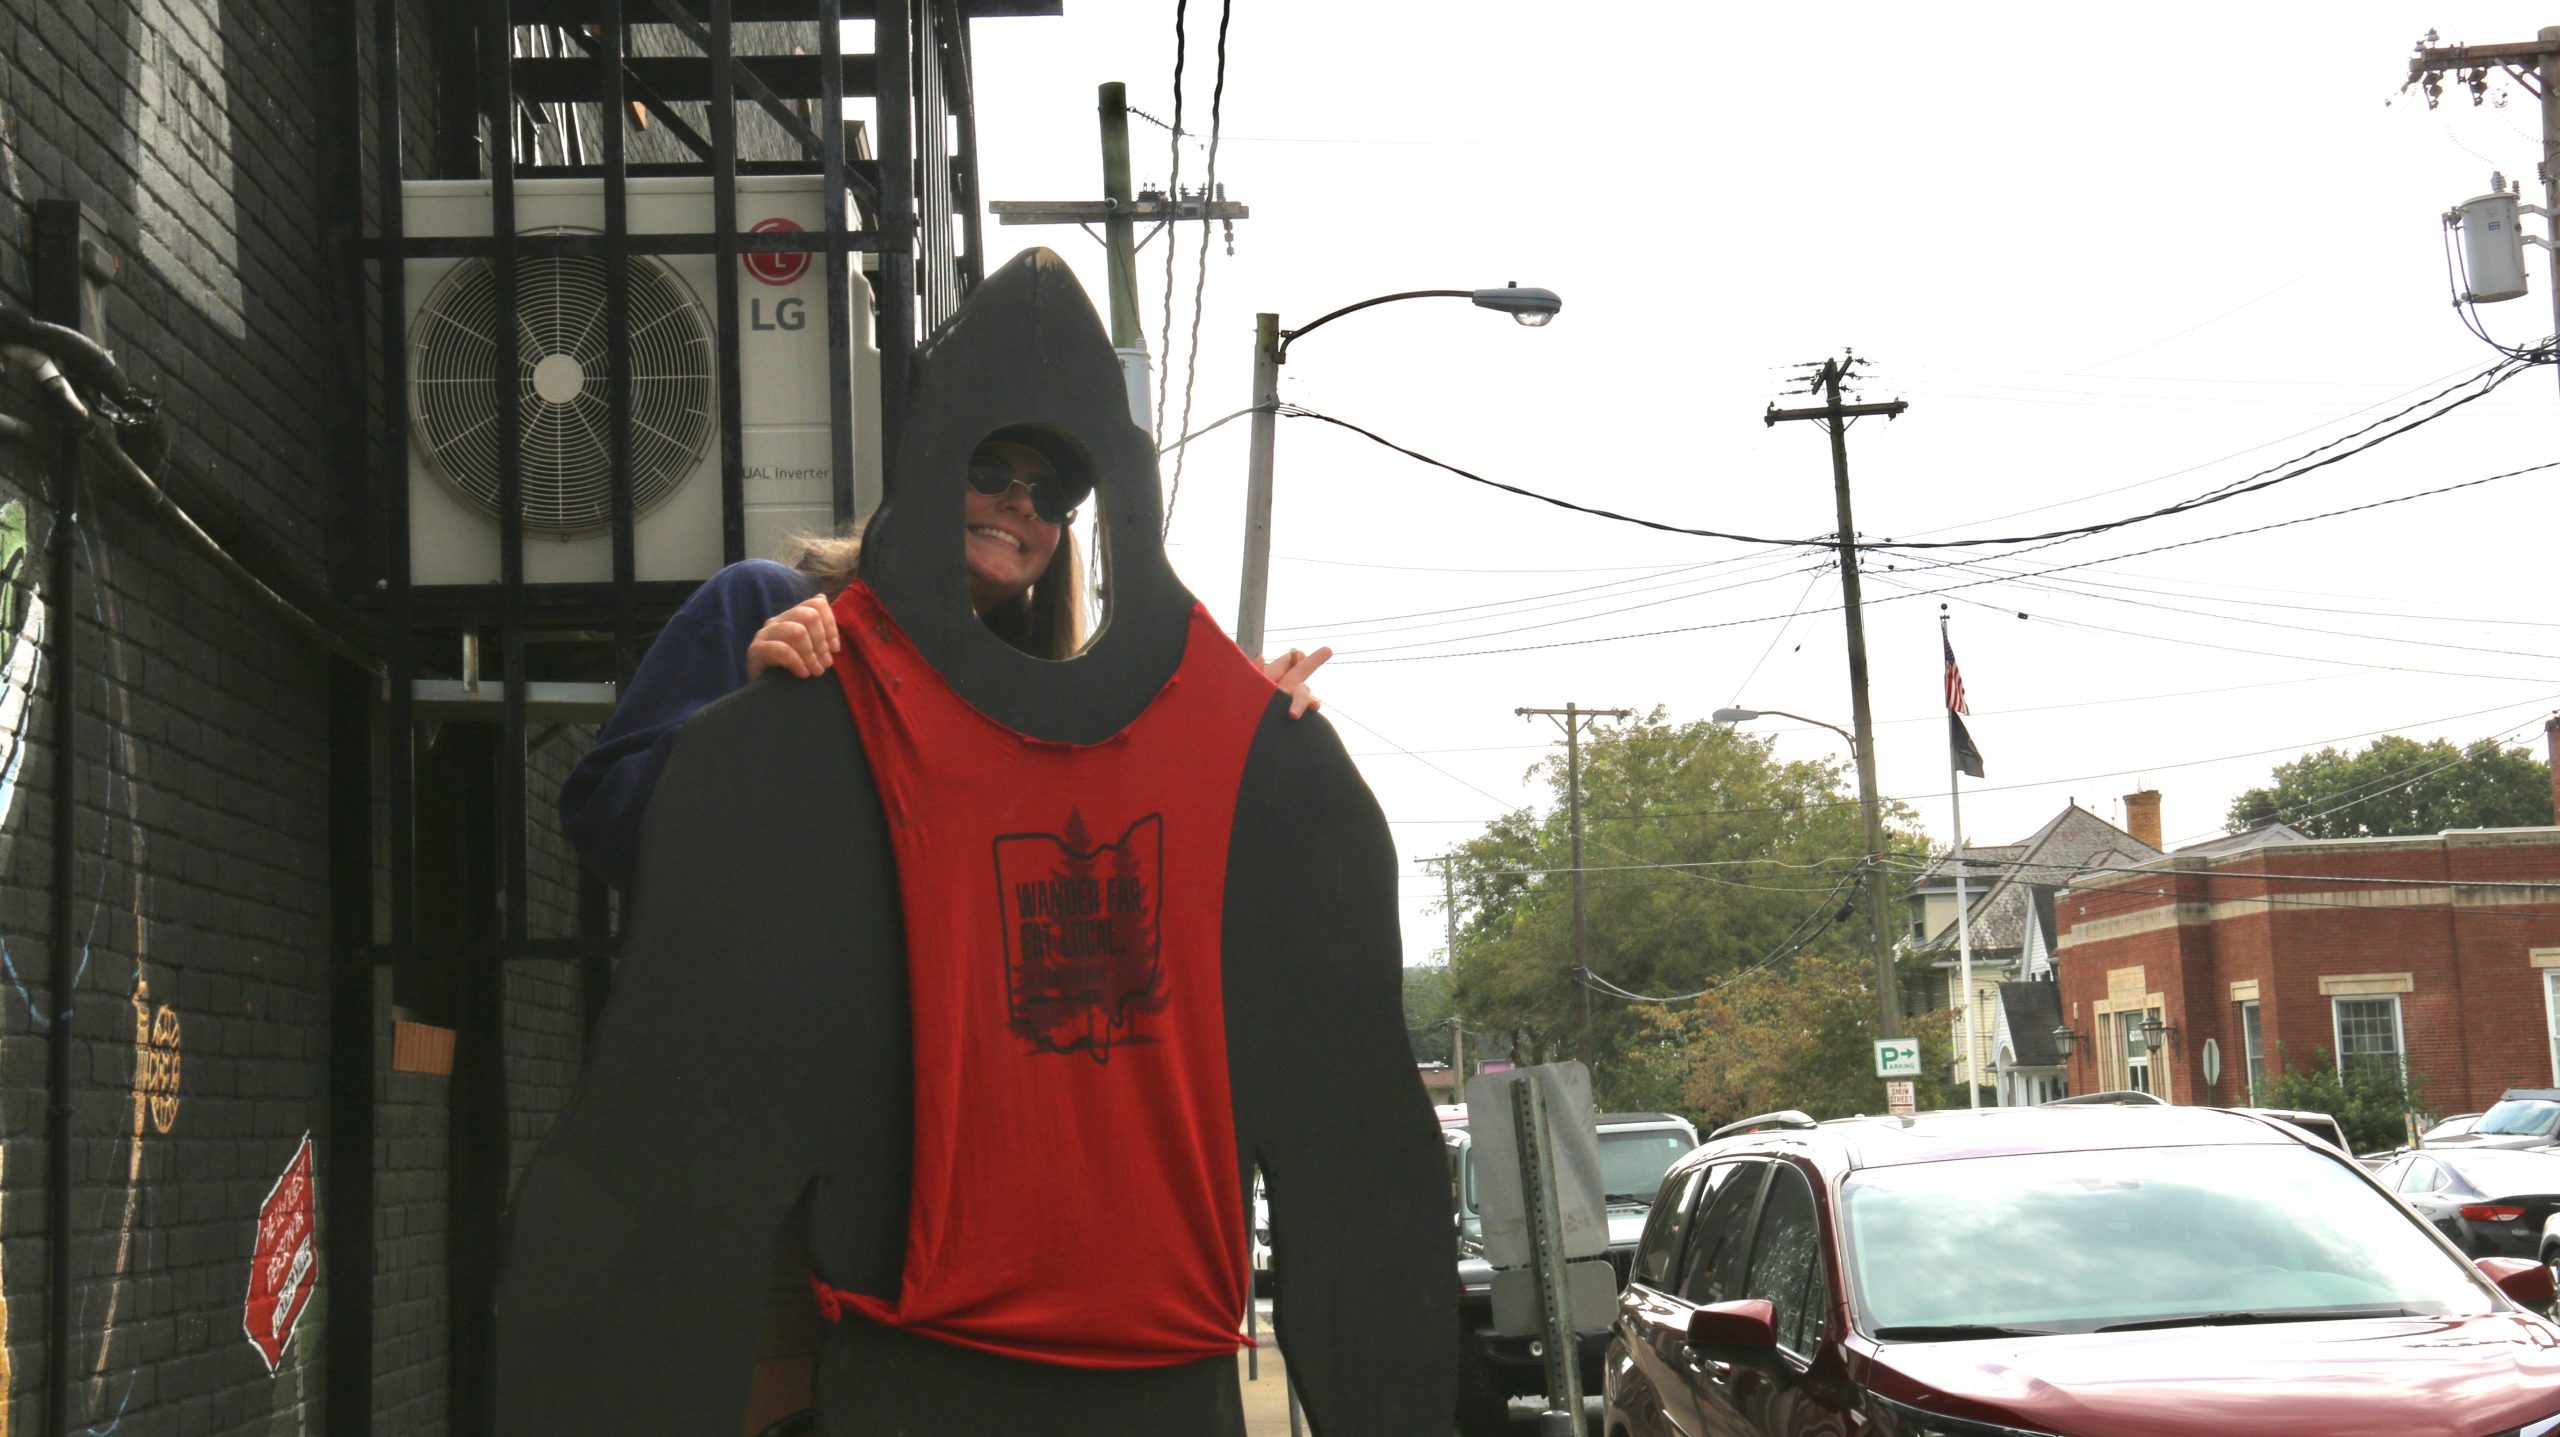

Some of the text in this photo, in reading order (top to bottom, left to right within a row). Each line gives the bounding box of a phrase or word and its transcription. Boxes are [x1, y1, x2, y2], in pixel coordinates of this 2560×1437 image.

[751, 297, 805, 331] LG
[743, 466, 830, 480] UAL Inverter
[1015, 879, 1099, 918] WANDER
[1021, 921, 1052, 961] EAT
[1890, 1095, 1912, 1103] STREET
[1891, 1088, 1909, 1096] SNOW
